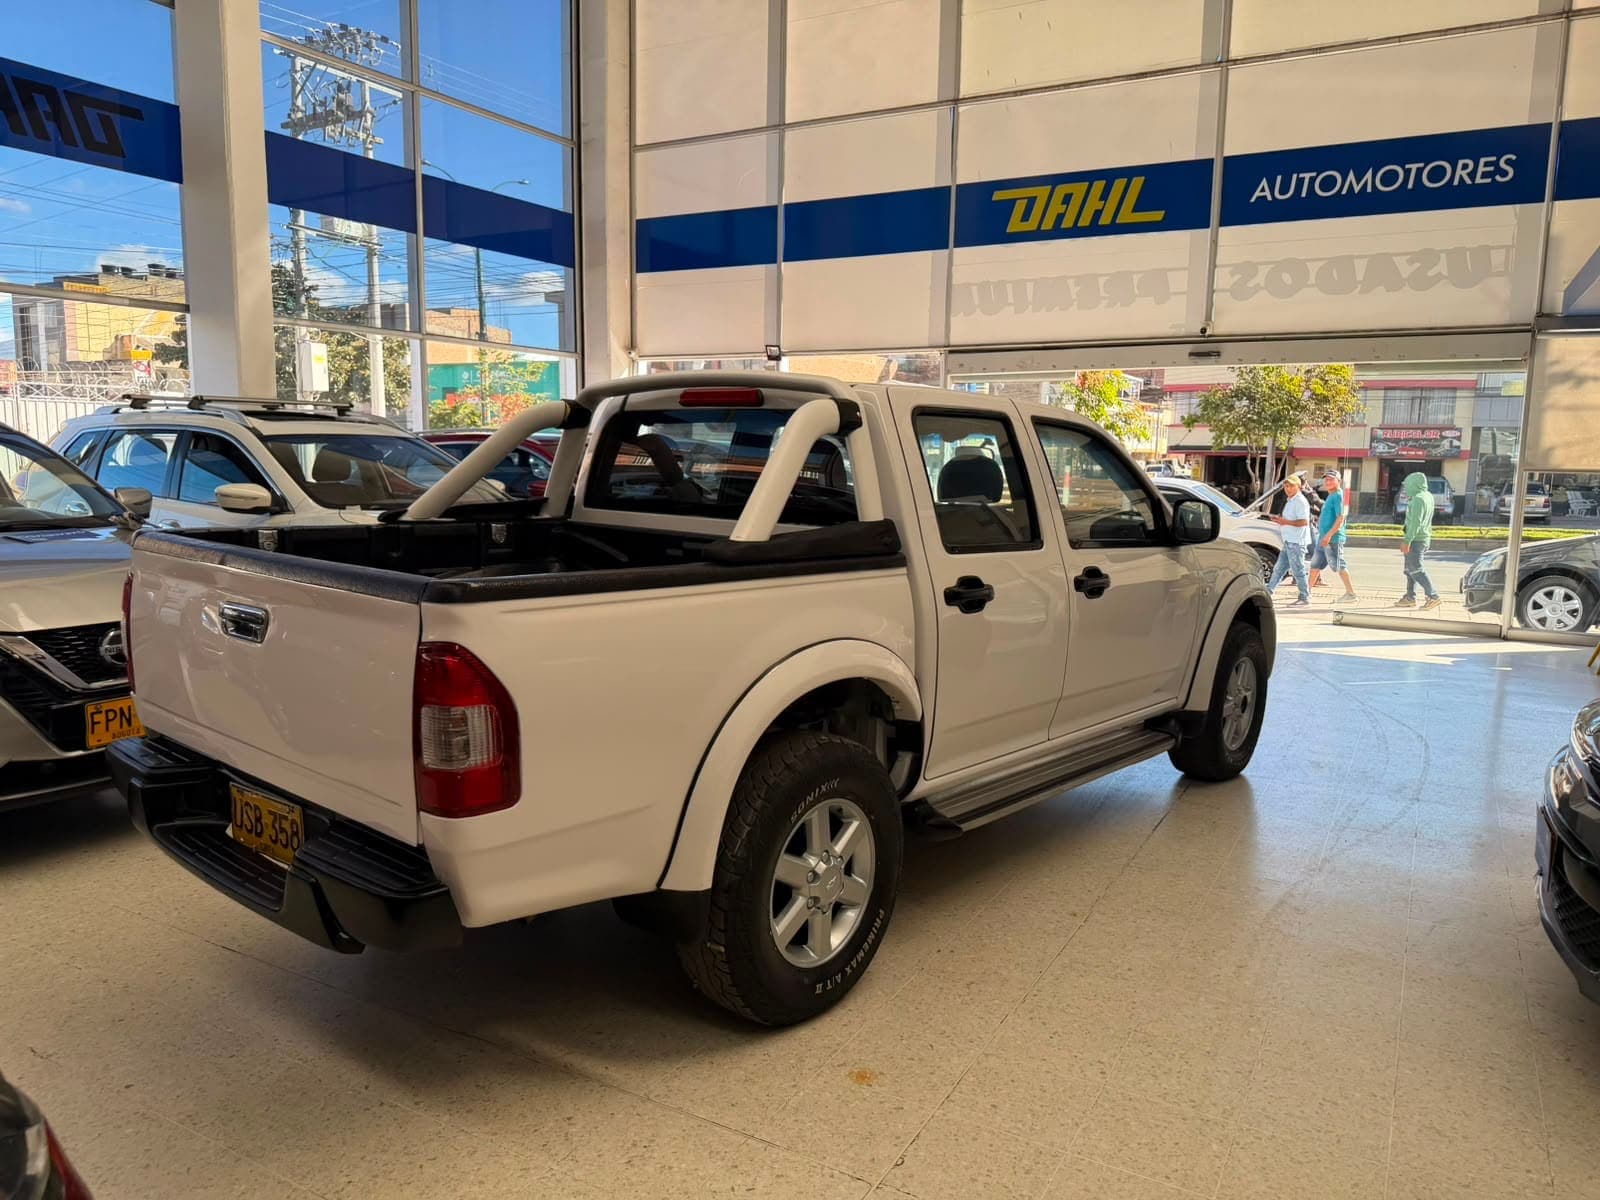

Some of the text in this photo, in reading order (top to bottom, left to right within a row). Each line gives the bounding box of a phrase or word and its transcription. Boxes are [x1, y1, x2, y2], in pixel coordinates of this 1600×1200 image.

[991, 153, 1518, 233] DAHL AUTOMOTORES
[89, 704, 132, 735] FPN
[233, 797, 301, 851] USB 358
